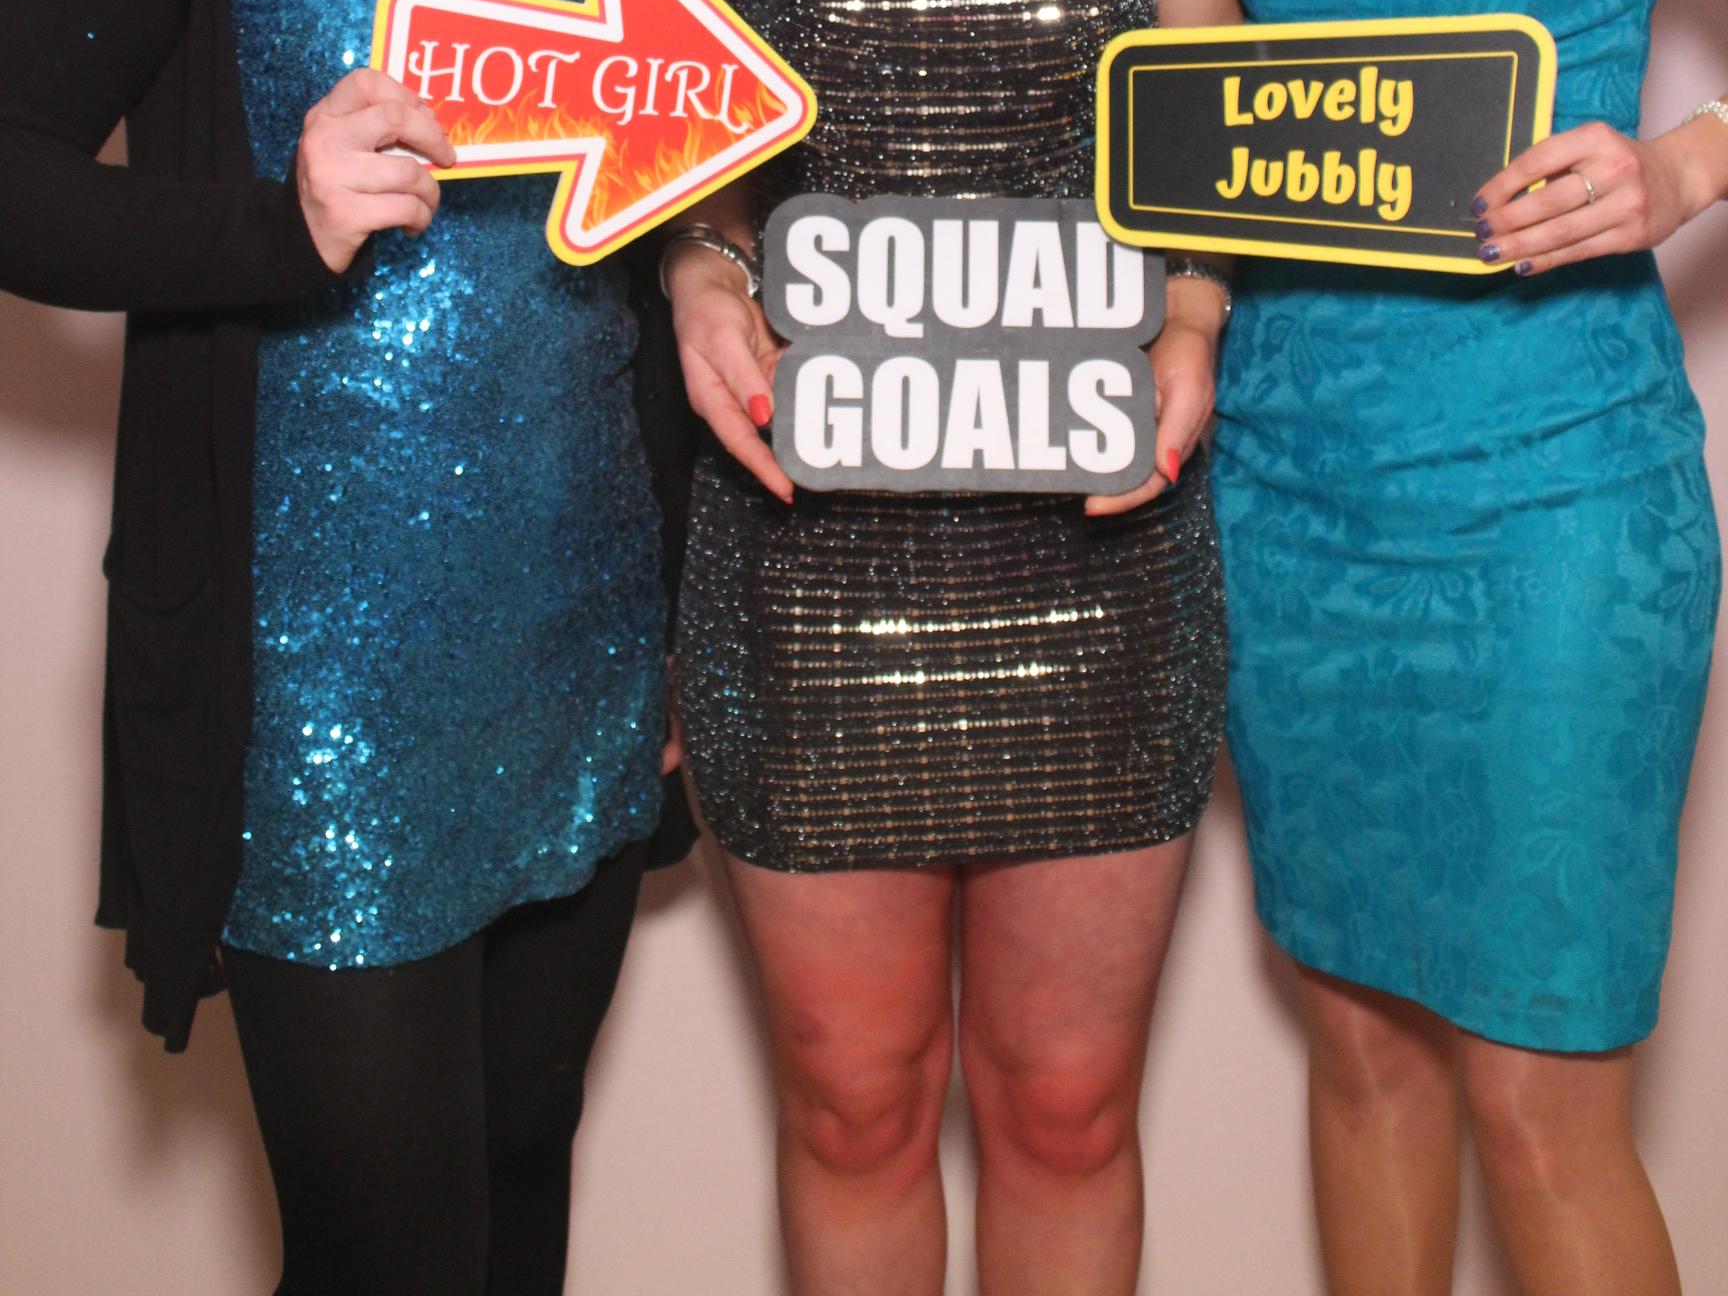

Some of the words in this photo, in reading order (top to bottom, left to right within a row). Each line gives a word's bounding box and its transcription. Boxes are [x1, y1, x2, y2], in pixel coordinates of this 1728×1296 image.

[408, 40, 581, 110] HOT
[592, 54, 749, 135] GIRL
[1223, 66, 1414, 137] Lovely
[1215, 147, 1413, 222] Jubbly
[785, 215, 1145, 339] SQUAD
[793, 354, 1136, 474] GOALS
